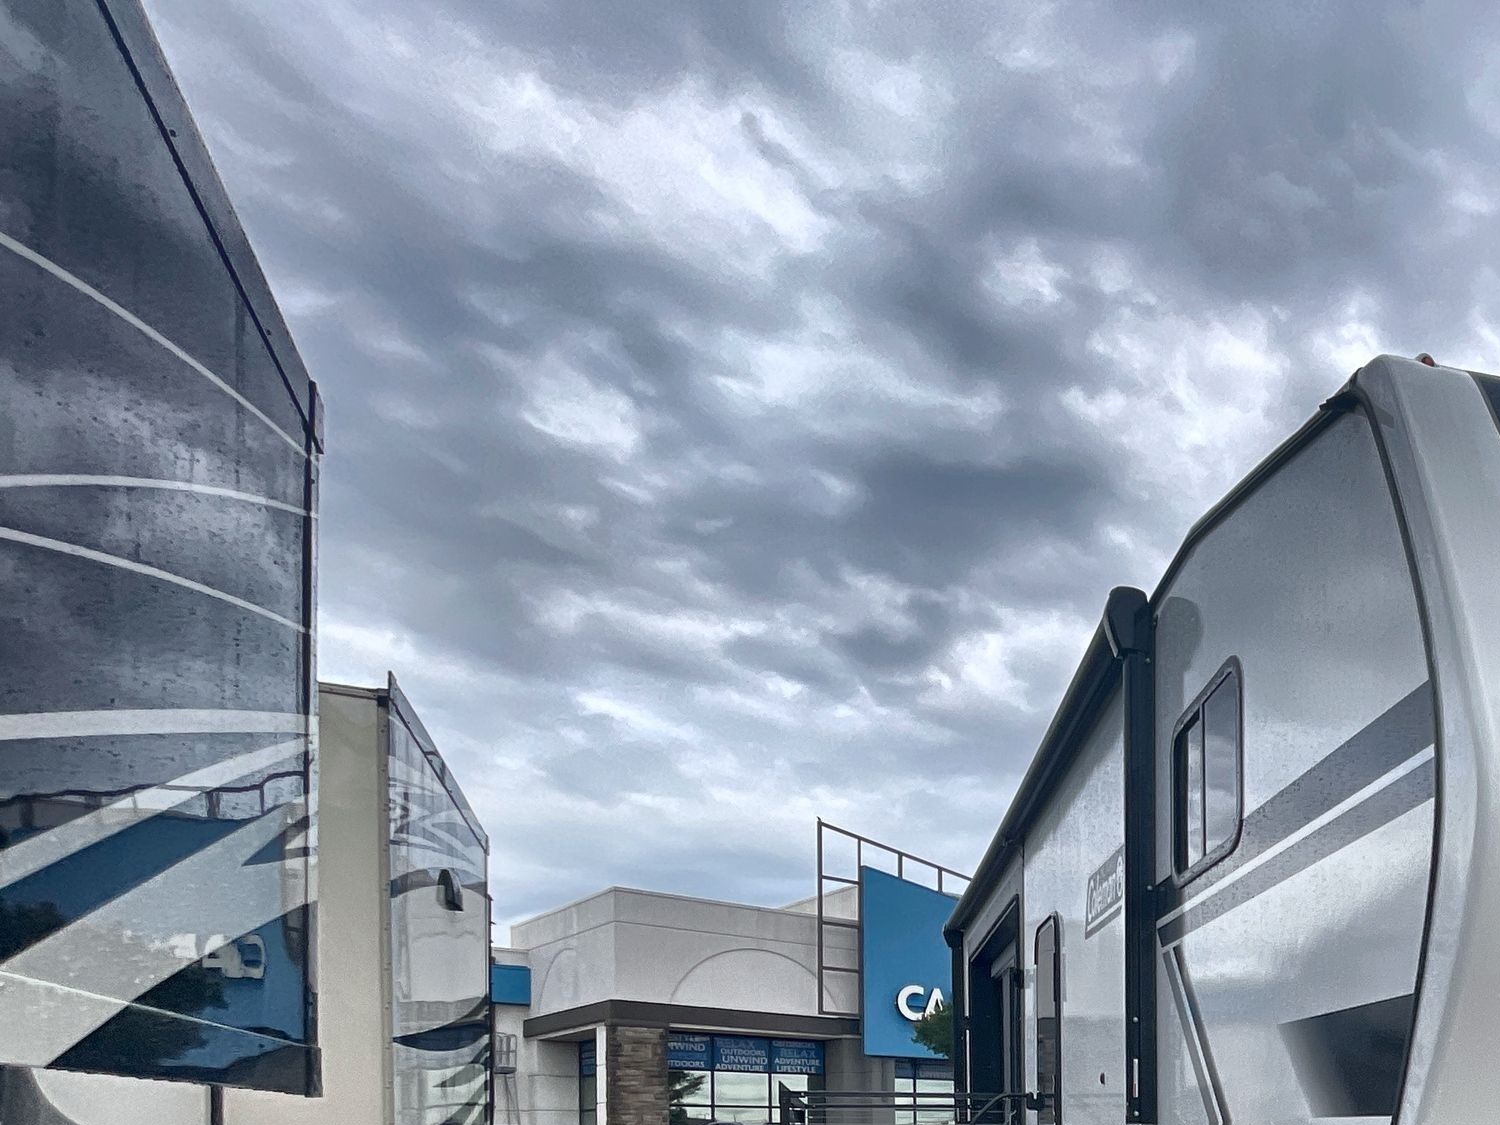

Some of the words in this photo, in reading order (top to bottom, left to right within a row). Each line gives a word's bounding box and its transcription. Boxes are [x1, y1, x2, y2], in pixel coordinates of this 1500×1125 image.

[720, 1048, 765, 1056] OUTDOORS
[780, 1048, 816, 1058] RELAX
[722, 1055, 768, 1065] UNWIND
[774, 1057, 820, 1066] ADVENTURE
[715, 1063, 764, 1072] ADVENTURE
[776, 1065, 816, 1074] LIFESTYLE
